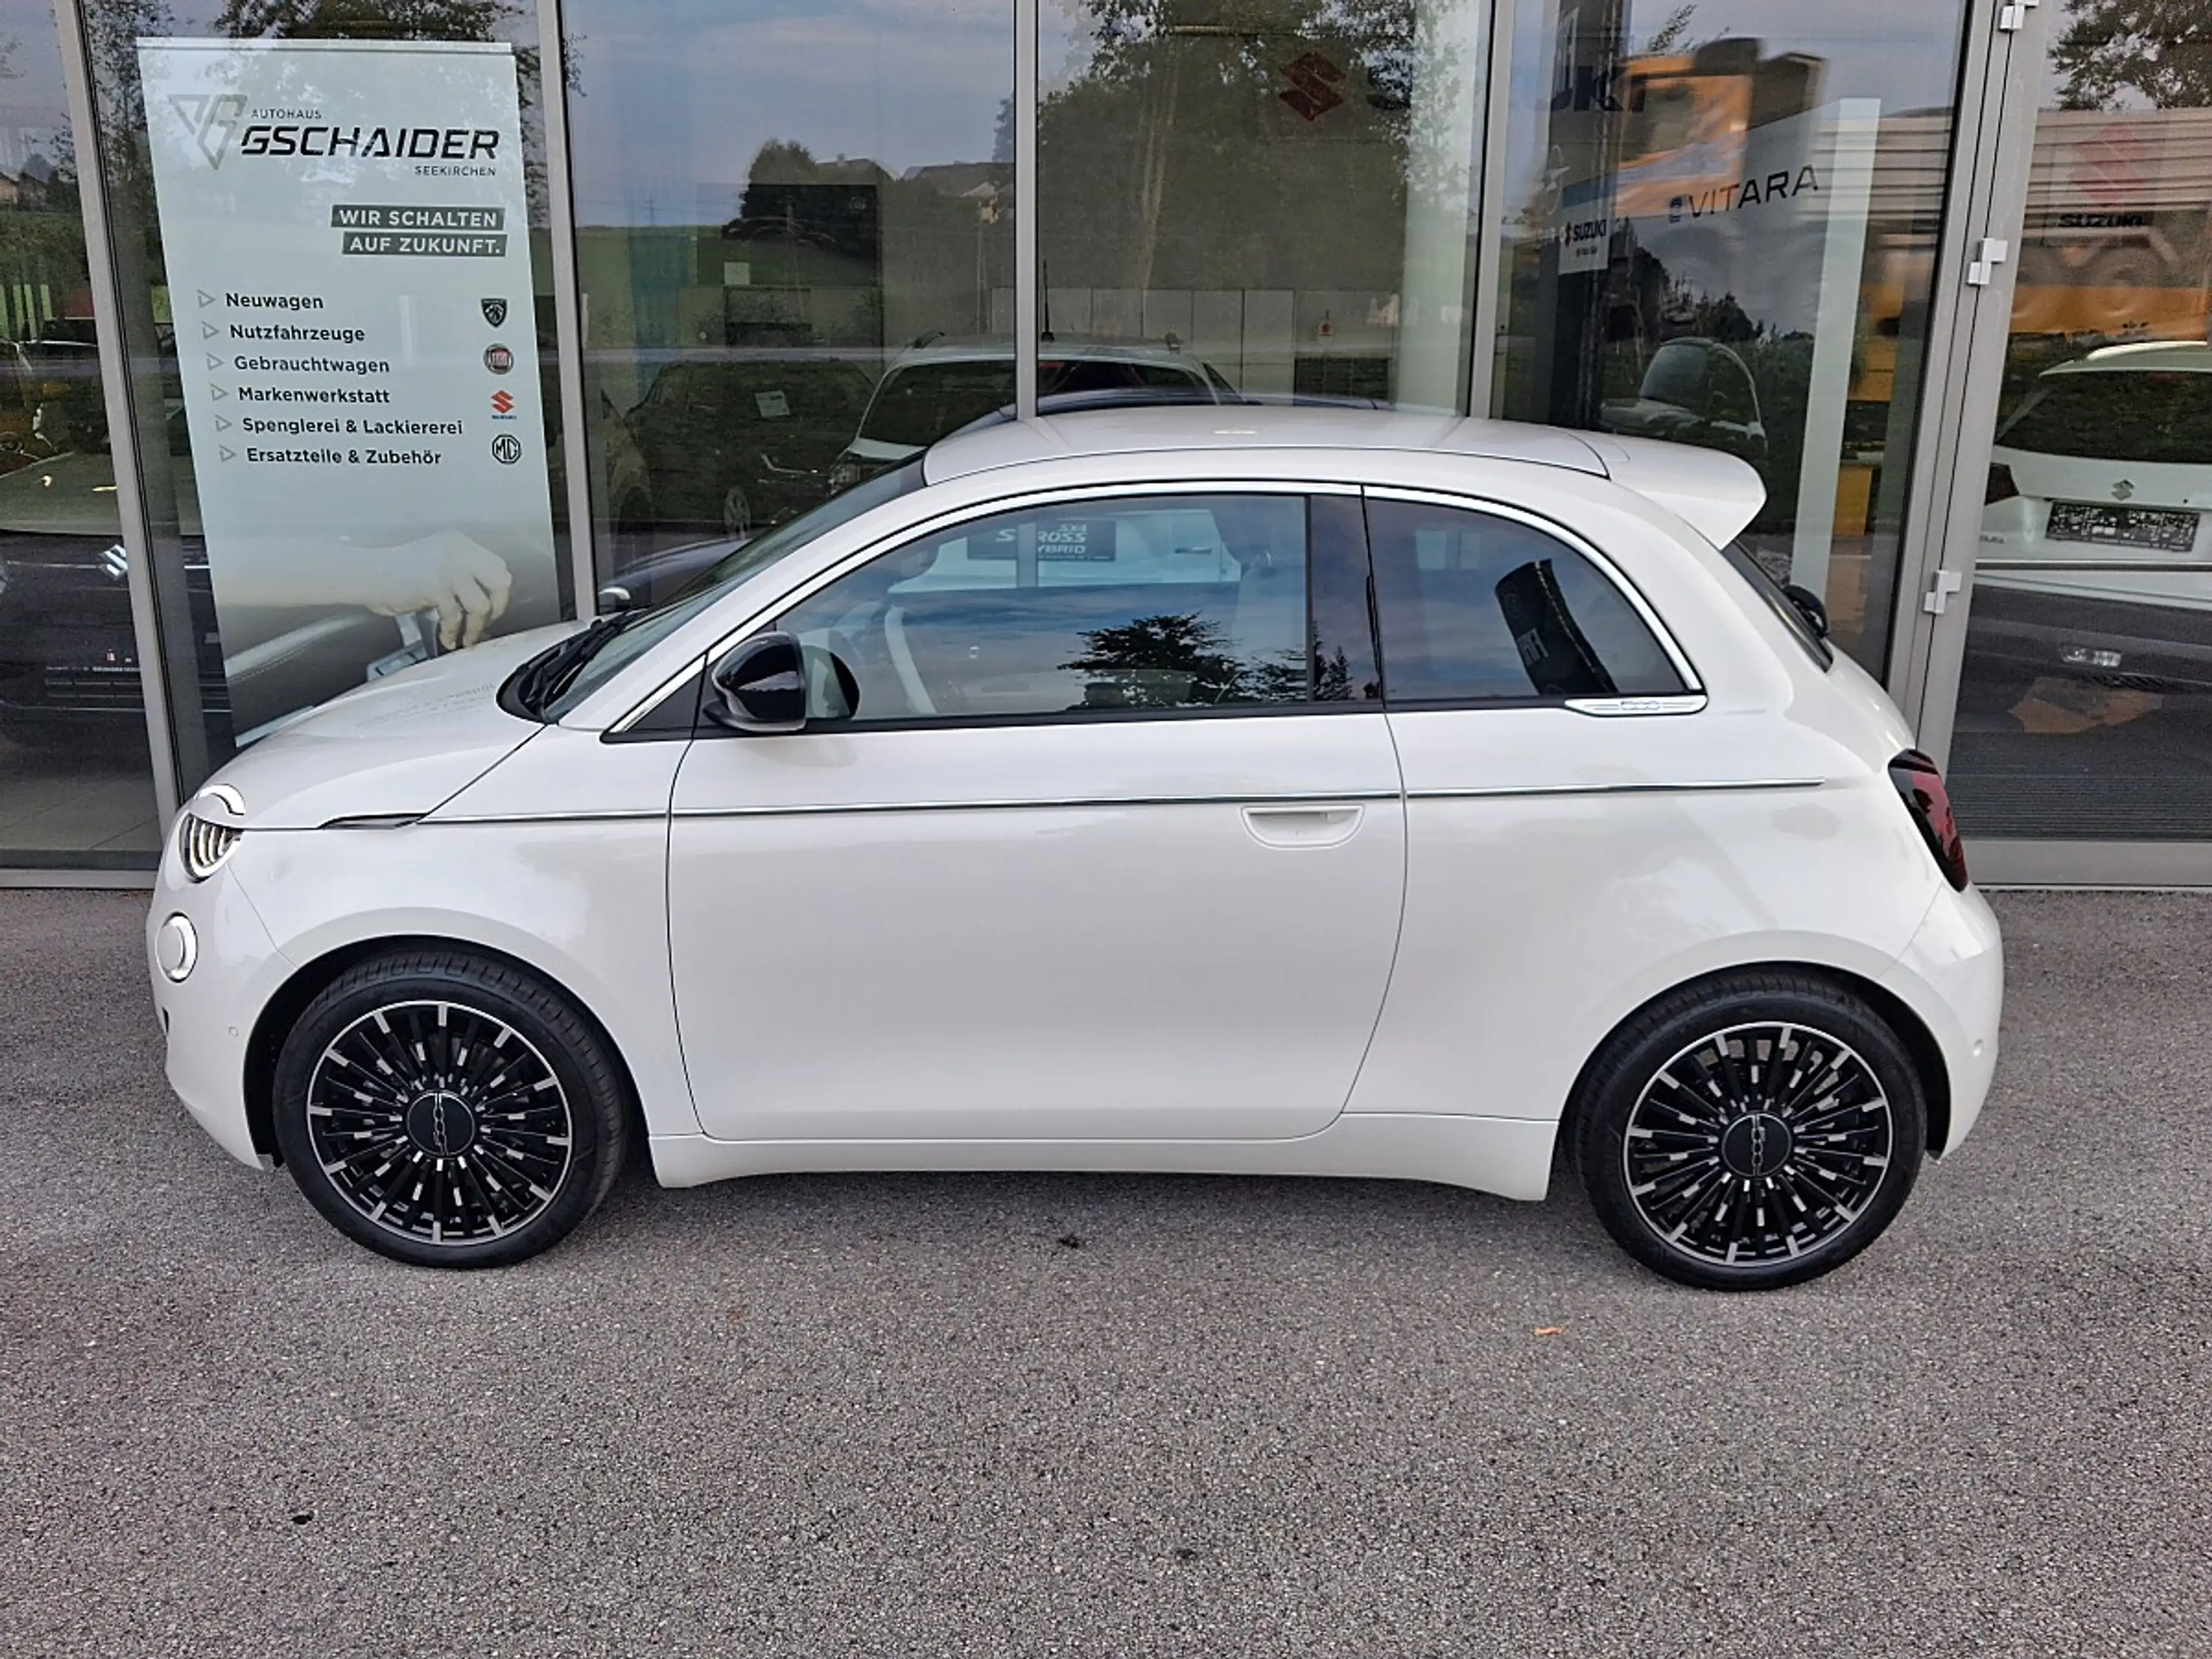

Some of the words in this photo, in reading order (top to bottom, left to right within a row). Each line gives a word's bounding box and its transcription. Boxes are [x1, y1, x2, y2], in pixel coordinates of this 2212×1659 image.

[251, 109, 321, 119] AUTOHAUS
[241, 126, 500, 158] GSCHAIDER
[414, 165, 496, 176] SEEKIRCHEN
[339, 210, 381, 225] WIR
[388, 211, 497, 226] SCHALTEN
[350, 237, 391, 251] AUF
[399, 238, 501, 253] ZUKUNFT.
[226, 293, 324, 310] Neuwagen
[230, 324, 365, 343] Nutzfahrzeuge
[234, 356, 390, 375] Gebrauchtwagen
[239, 387, 390, 403] Markenwerkstatt
[243, 418, 340, 434] Spenglerei
[346, 421, 357, 432] &
[363, 419, 463, 434] Lackiererei
[247, 448, 342, 462] Ersatzteile
[348, 450, 359, 463] &
[365, 449, 441, 464] Zubehör
